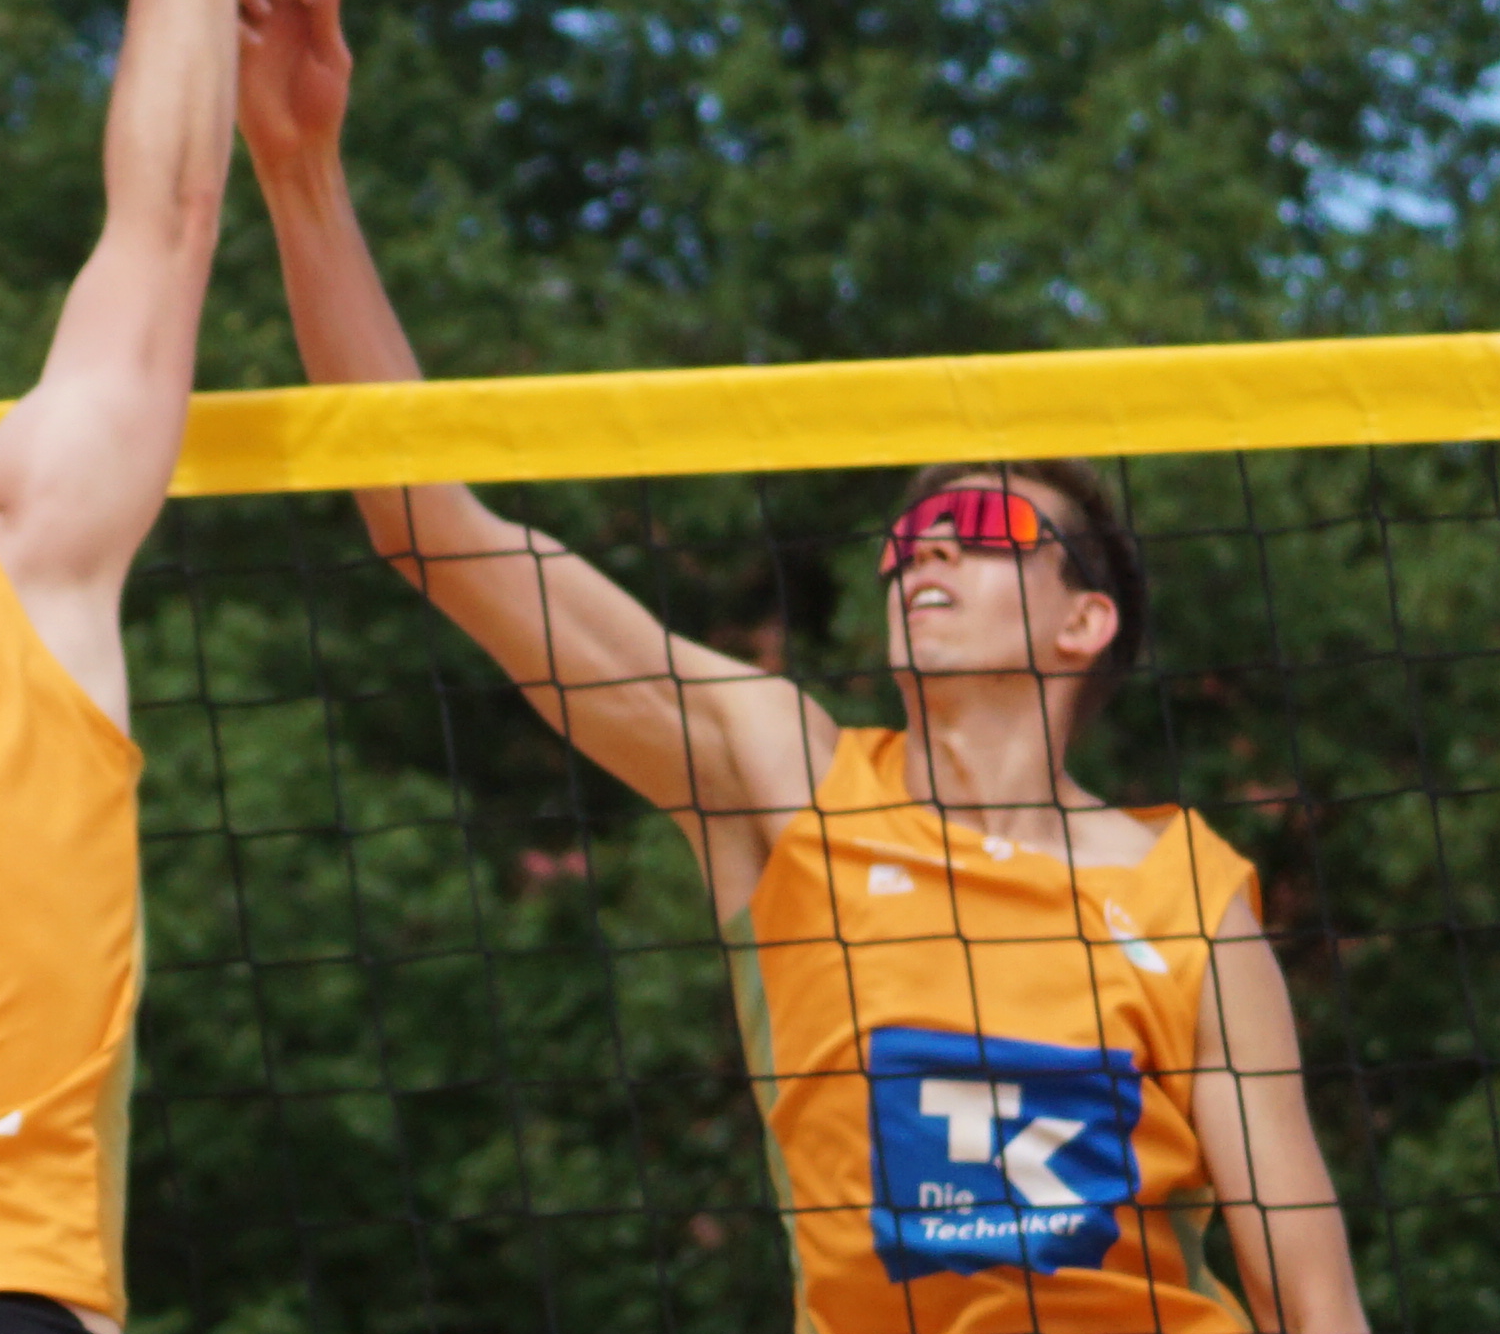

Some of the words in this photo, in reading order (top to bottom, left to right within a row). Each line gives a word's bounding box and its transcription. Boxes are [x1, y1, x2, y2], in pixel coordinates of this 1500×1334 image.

[919, 1078, 1087, 1207] TK
[918, 1181, 975, 1216] Die
[919, 1212, 1086, 1242] Techniker
